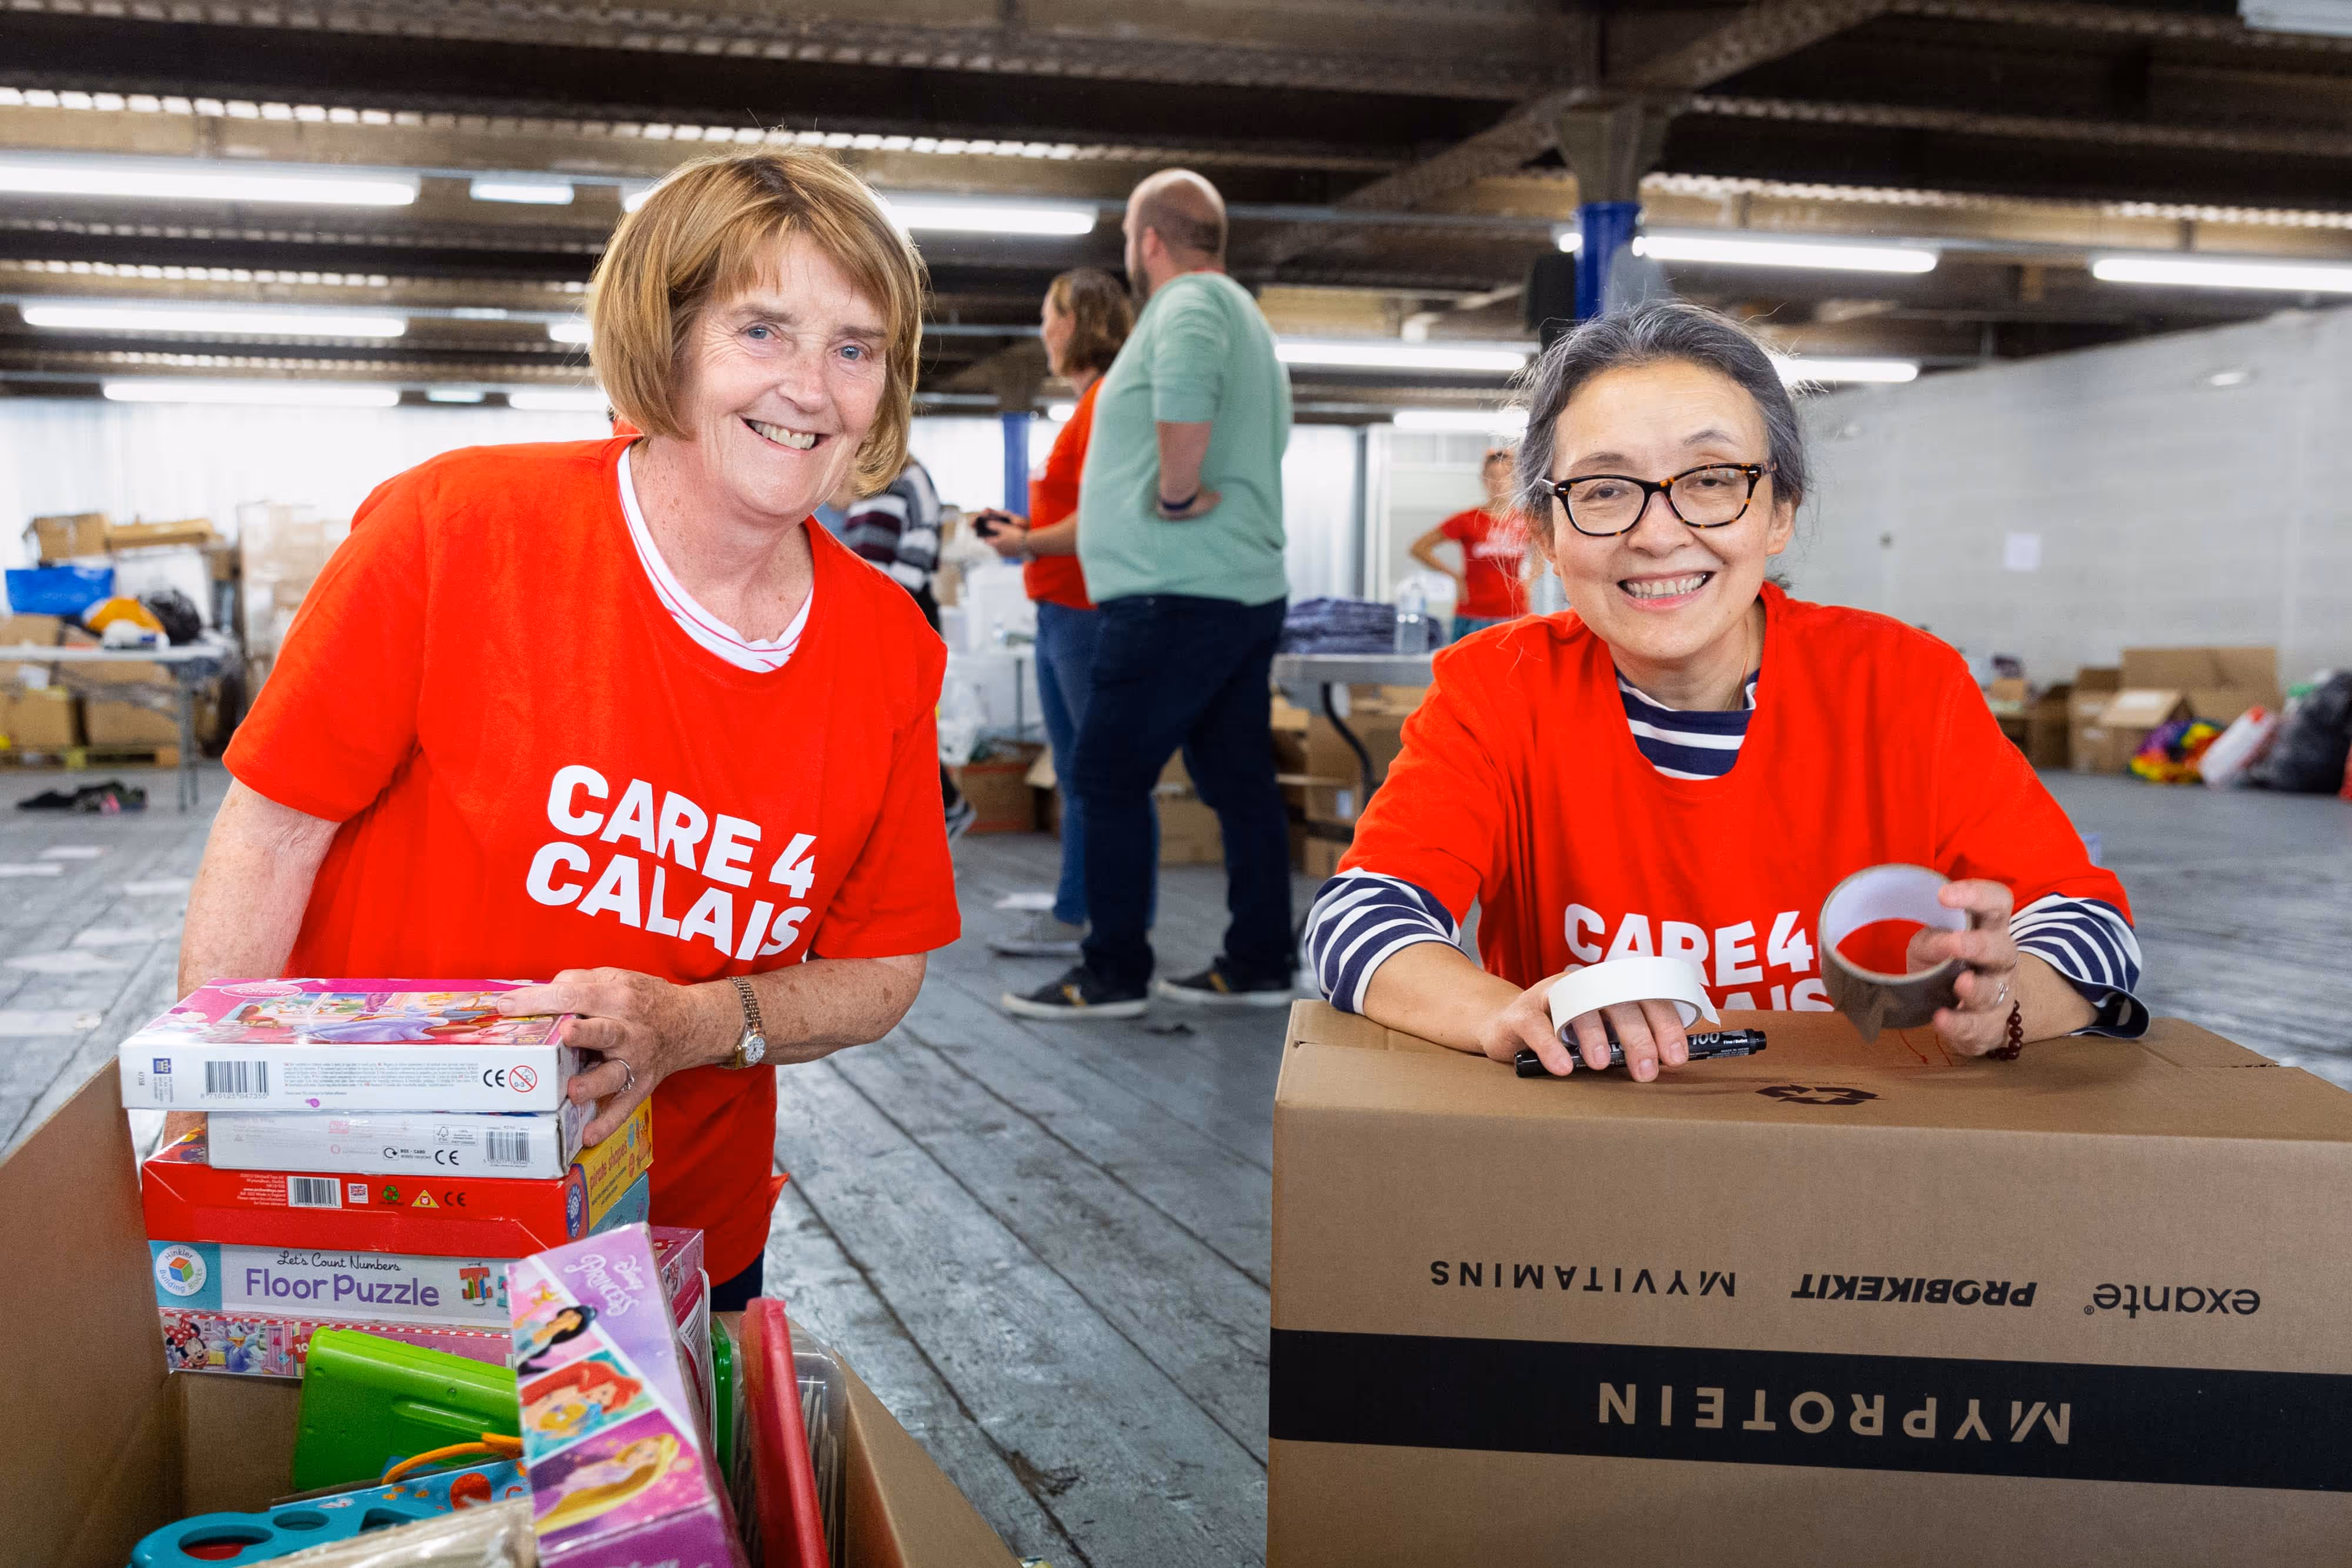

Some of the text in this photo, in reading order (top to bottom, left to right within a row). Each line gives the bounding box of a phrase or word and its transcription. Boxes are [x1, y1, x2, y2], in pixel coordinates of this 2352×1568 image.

[547, 764, 817, 899] CARE 4
[526, 841, 812, 961] CALAIS
[1565, 903, 1814, 987] CARE 4
[1690, 1032, 1720, 1045] 100
[483, 1069, 505, 1088] CE
[435, 1150, 459, 1165] CE
[444, 1192, 466, 1206] CE
[165, 1249, 194, 1260] Hinkler
[277, 1251, 401, 1272] Let's Count Numbers
[159, 1269, 186, 1293] Building
[188, 1268, 203, 1290] Blocks
[246, 1268, 440, 1307] Floor Puzzle
[1430, 1260, 1736, 1297] MYVITAMINS
[1790, 1273, 2038, 1308] PROBIKEKIT
[1598, 1382, 2072, 1445] MYPROTEIN
